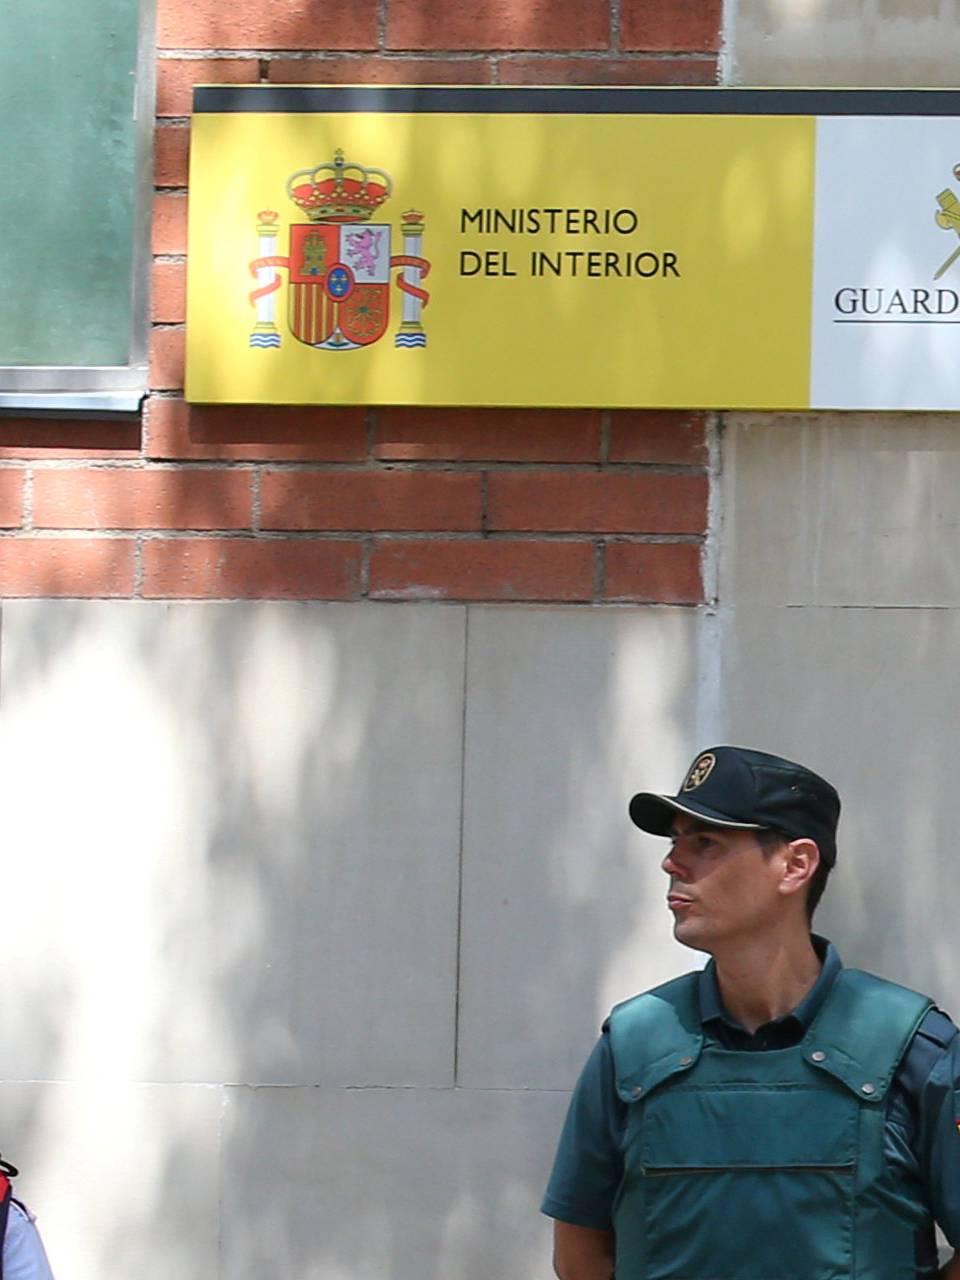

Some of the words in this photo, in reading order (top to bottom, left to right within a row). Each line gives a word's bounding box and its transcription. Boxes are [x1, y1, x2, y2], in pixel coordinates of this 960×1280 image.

[460, 208, 638, 235] MINISTERIO
[459, 251, 517, 277] DEL
[531, 251, 681, 278] INTERIOR
